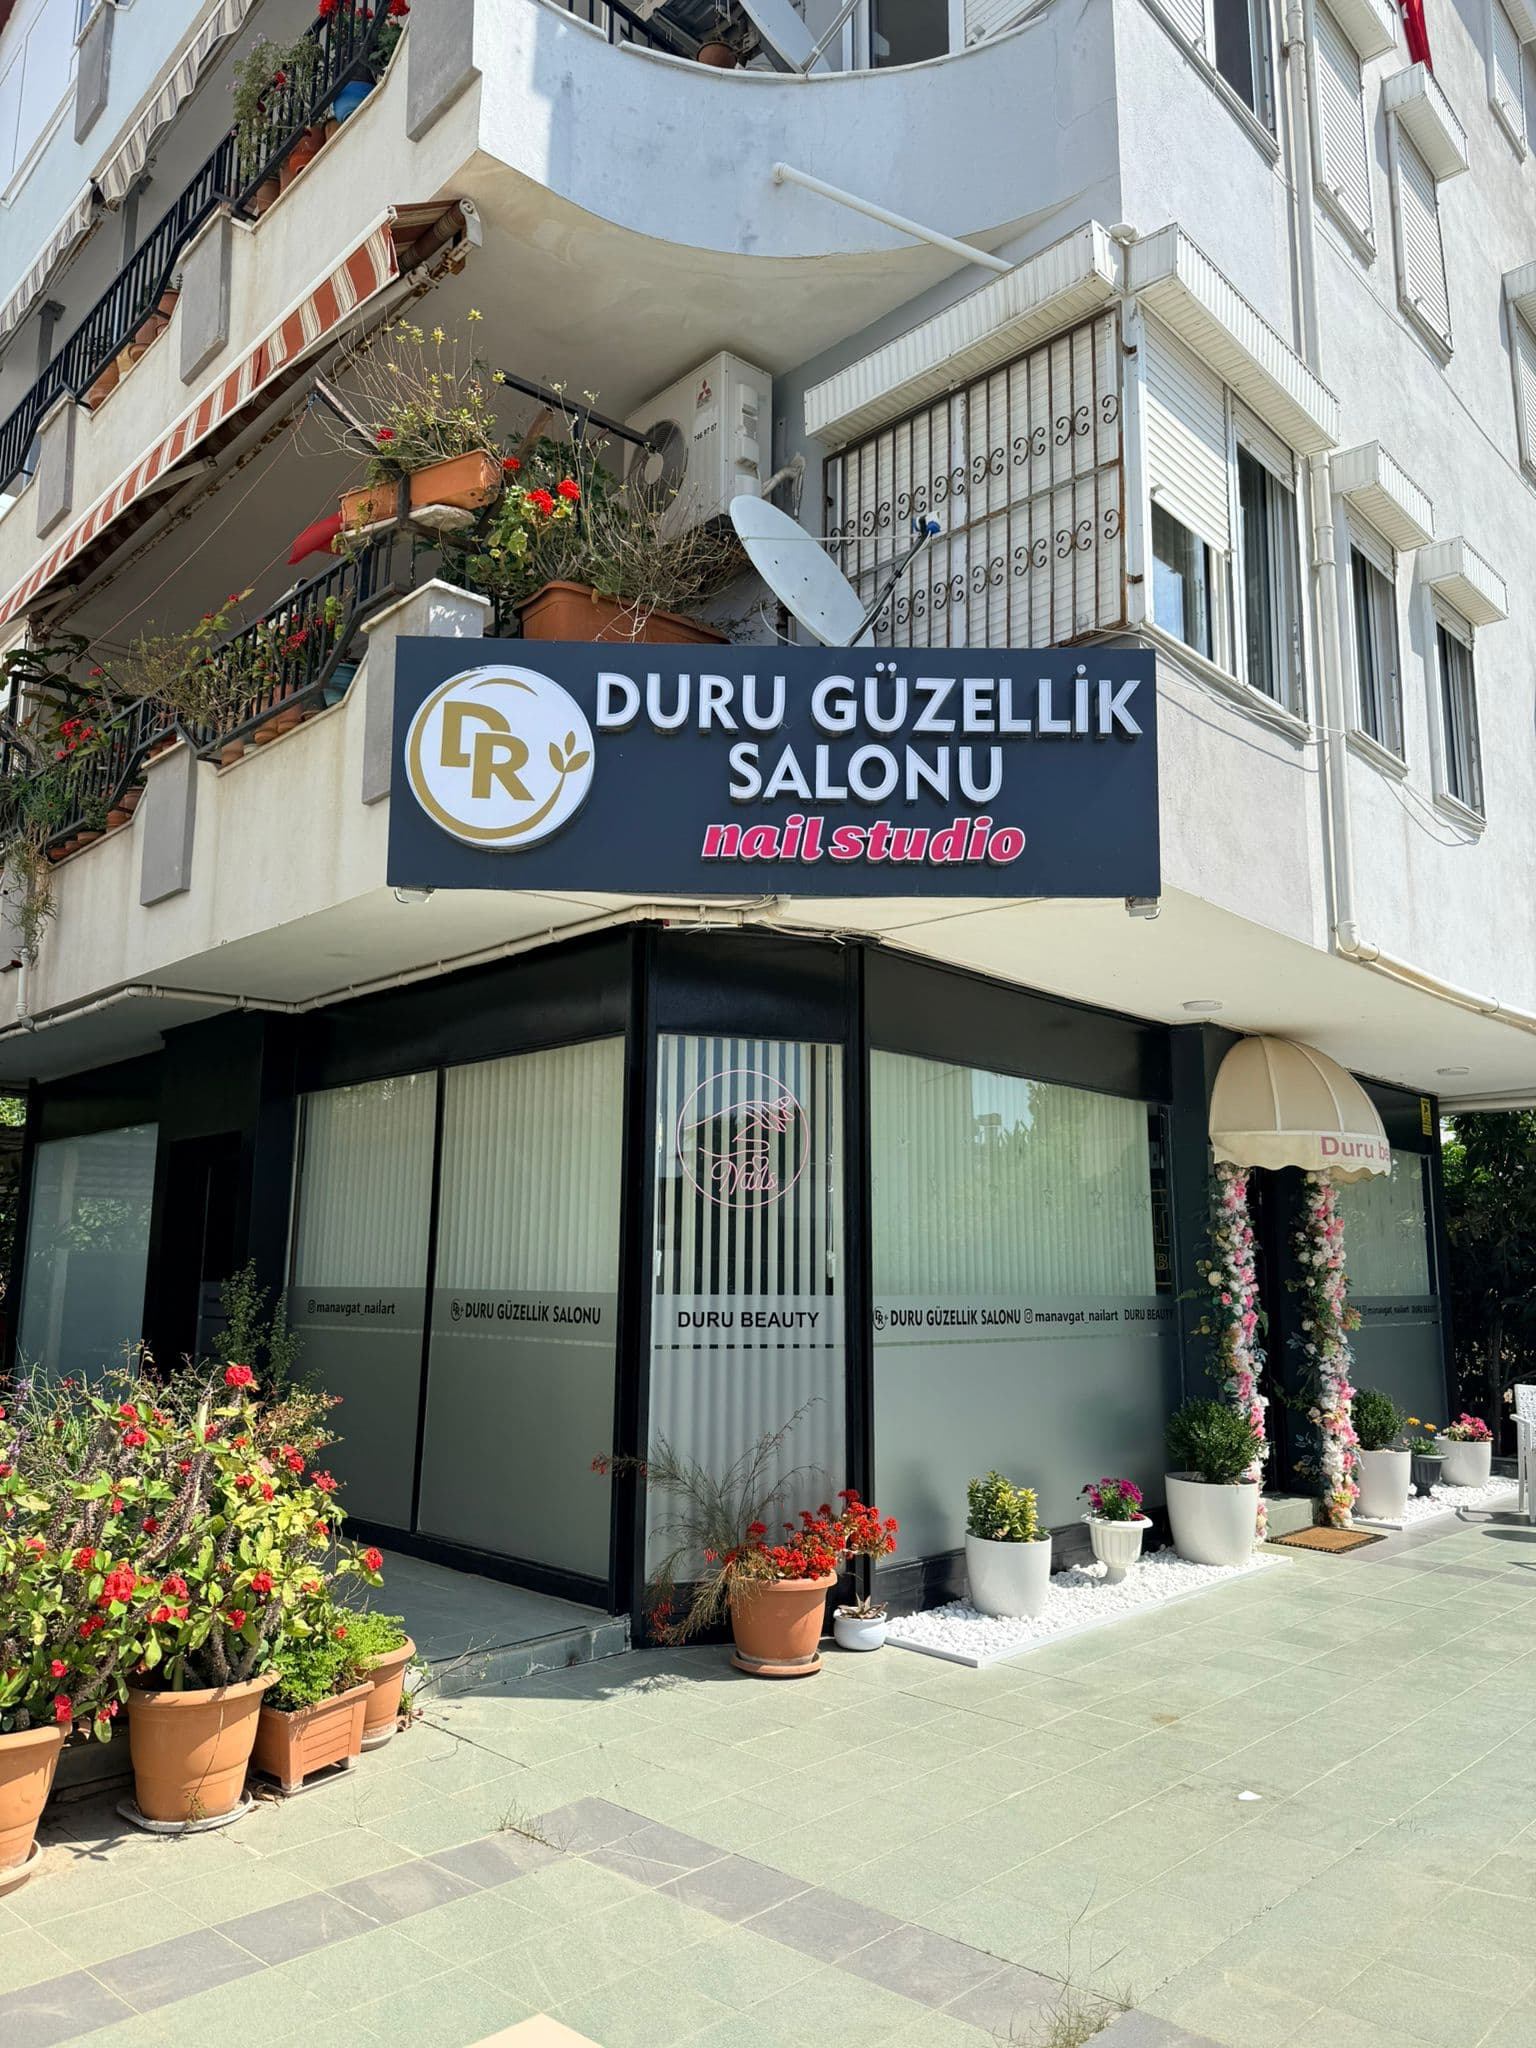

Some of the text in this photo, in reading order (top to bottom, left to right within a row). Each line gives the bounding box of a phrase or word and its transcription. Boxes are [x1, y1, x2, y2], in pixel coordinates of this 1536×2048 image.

[596, 662, 1143, 738] DURU GÜZELLİK
[440, 701, 536, 802] DR
[729, 743, 1004, 804] SALONU
[701, 814, 1026, 865] nail studio
[1320, 1136, 1374, 1158] Duru
[712, 1156, 778, 1195] Nails
[316, 1299, 395, 1316] manavgat_nailart
[465, 1302, 495, 1319] DURU
[497, 1300, 550, 1322] GÜZELLİK
[553, 1305, 601, 1325] SALONU
[677, 1312, 820, 1328] DURU BEAUTY
[890, 1309, 923, 1326] DURU
[926, 1306, 978, 1325] GÜZELLİK
[981, 1309, 1021, 1325] SALONU
[1035, 1309, 1119, 1325] manavgat_nailart
[1124, 1309, 1146, 1320] DURU
